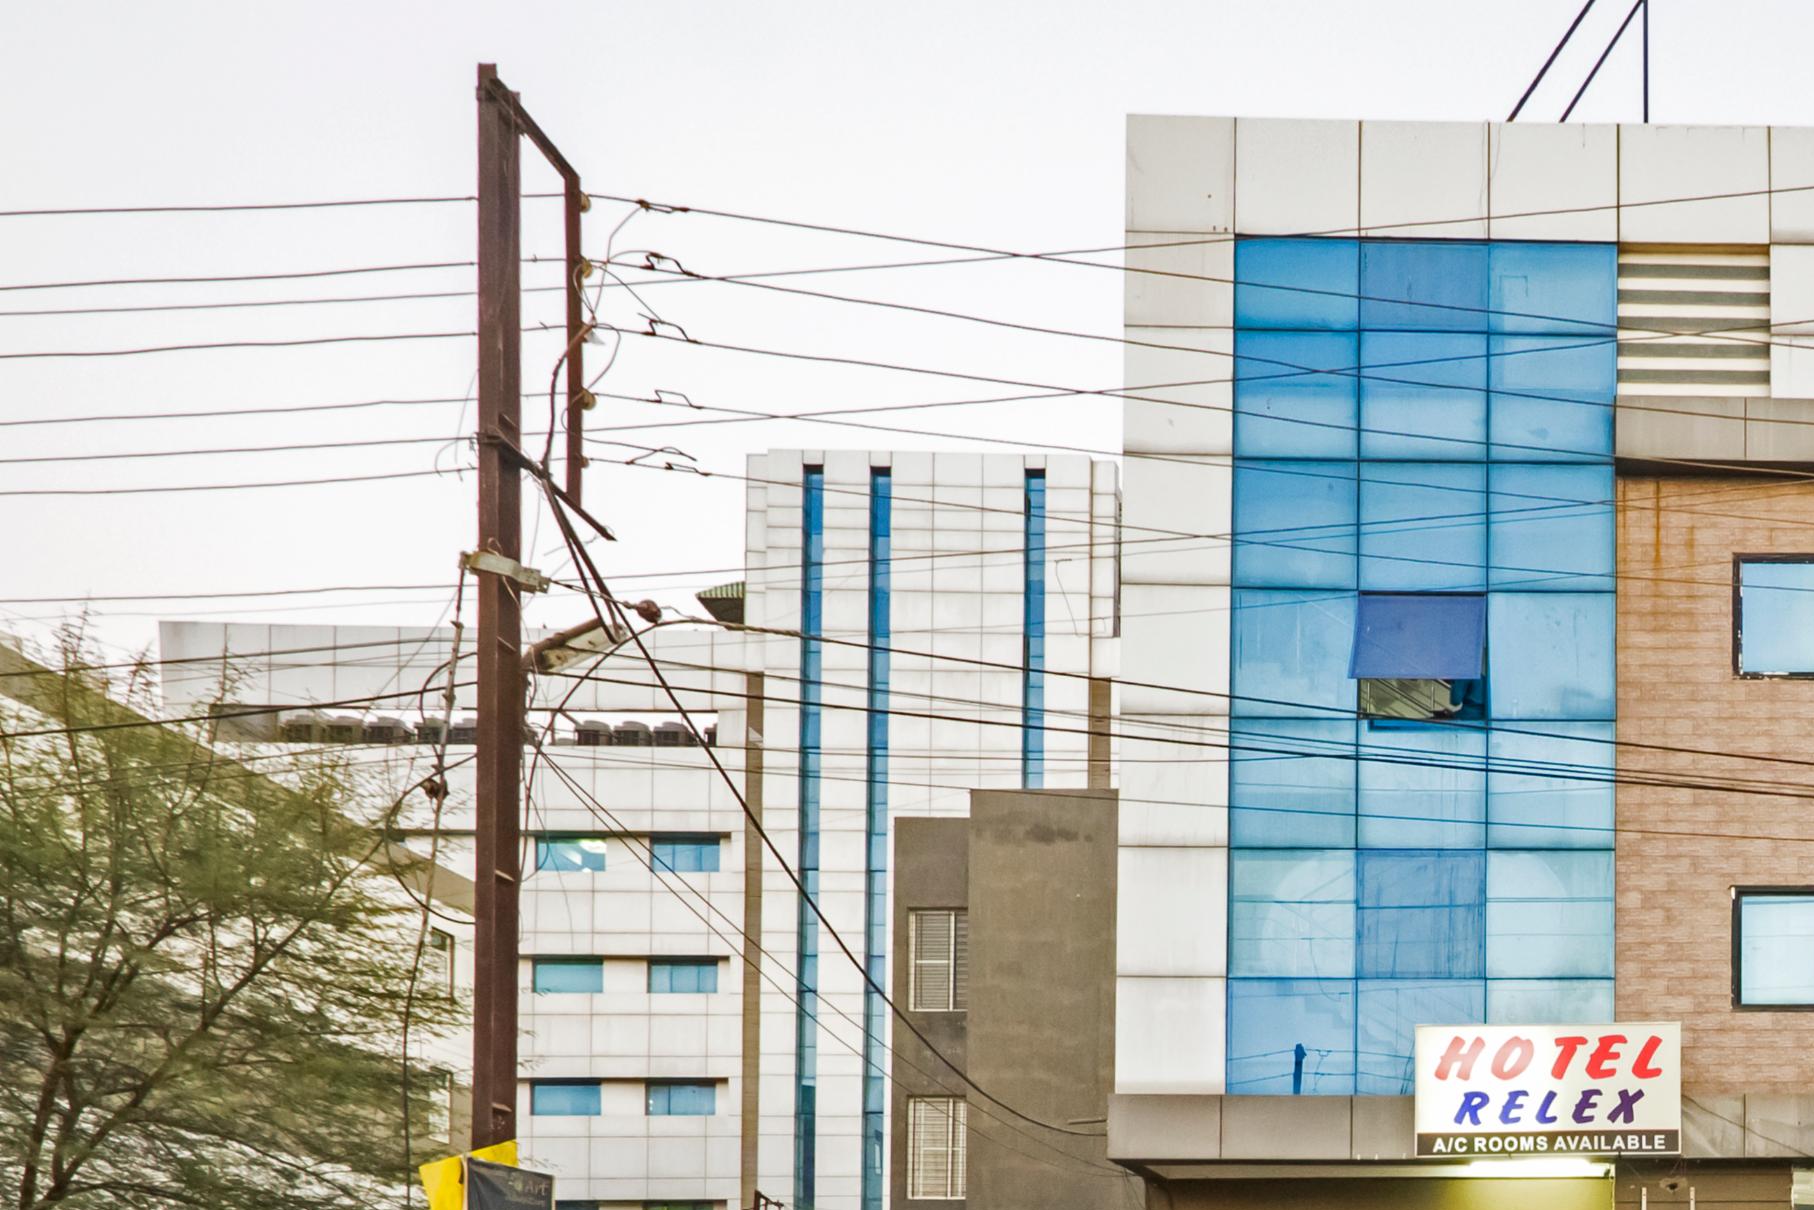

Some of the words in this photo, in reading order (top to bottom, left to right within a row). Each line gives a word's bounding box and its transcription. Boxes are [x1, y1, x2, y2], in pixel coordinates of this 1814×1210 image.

[1434, 1034, 1663, 1081] HOTEL
[1453, 1088, 1646, 1126] RELEX
[1432, 1136, 1469, 1153] A/C
[1474, 1135, 1549, 1152] ROOMS
[1553, 1134, 1666, 1151] AVAILABLE
